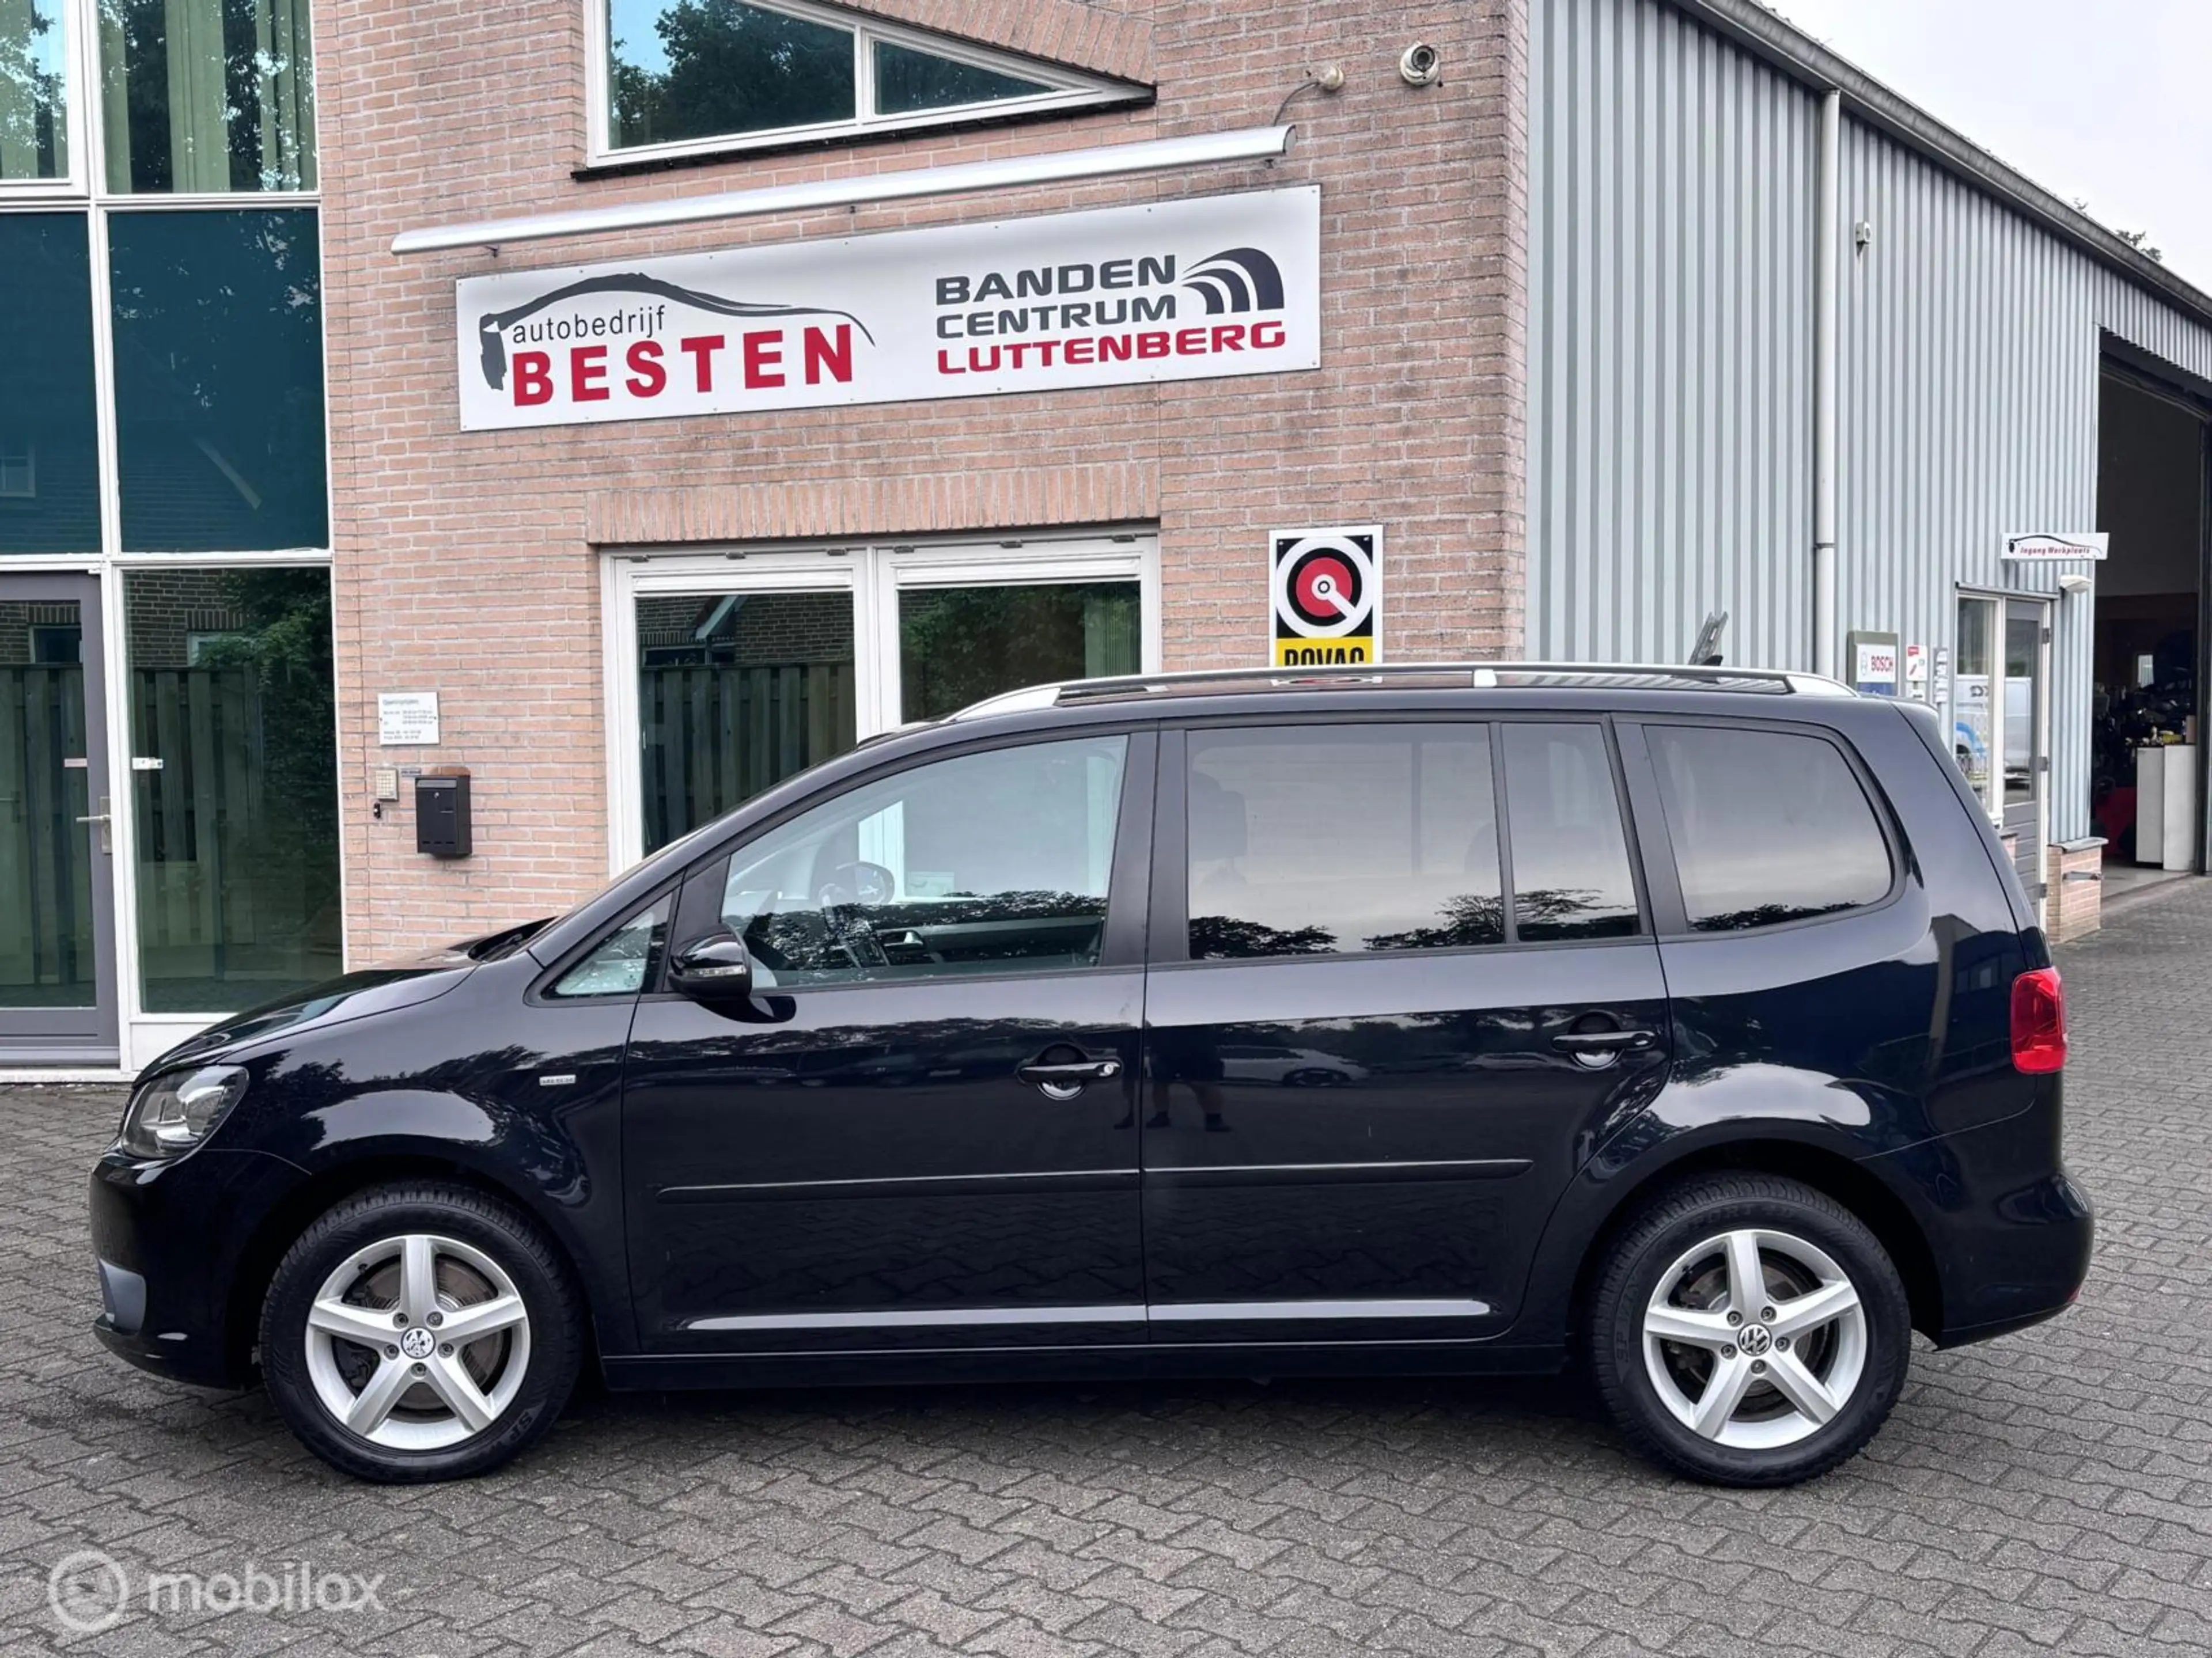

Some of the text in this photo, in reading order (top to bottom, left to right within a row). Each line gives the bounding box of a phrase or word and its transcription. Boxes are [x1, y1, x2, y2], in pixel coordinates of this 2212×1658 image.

[936, 255, 1176, 305] BANDEN
[513, 305, 666, 343] autobedrijf
[936, 294, 1177, 339] CENTRUM
[512, 323, 853, 407] BESTEN
[937, 320, 1286, 375] LUTTENBERG
[2020, 547, 2046, 556] Ingang
